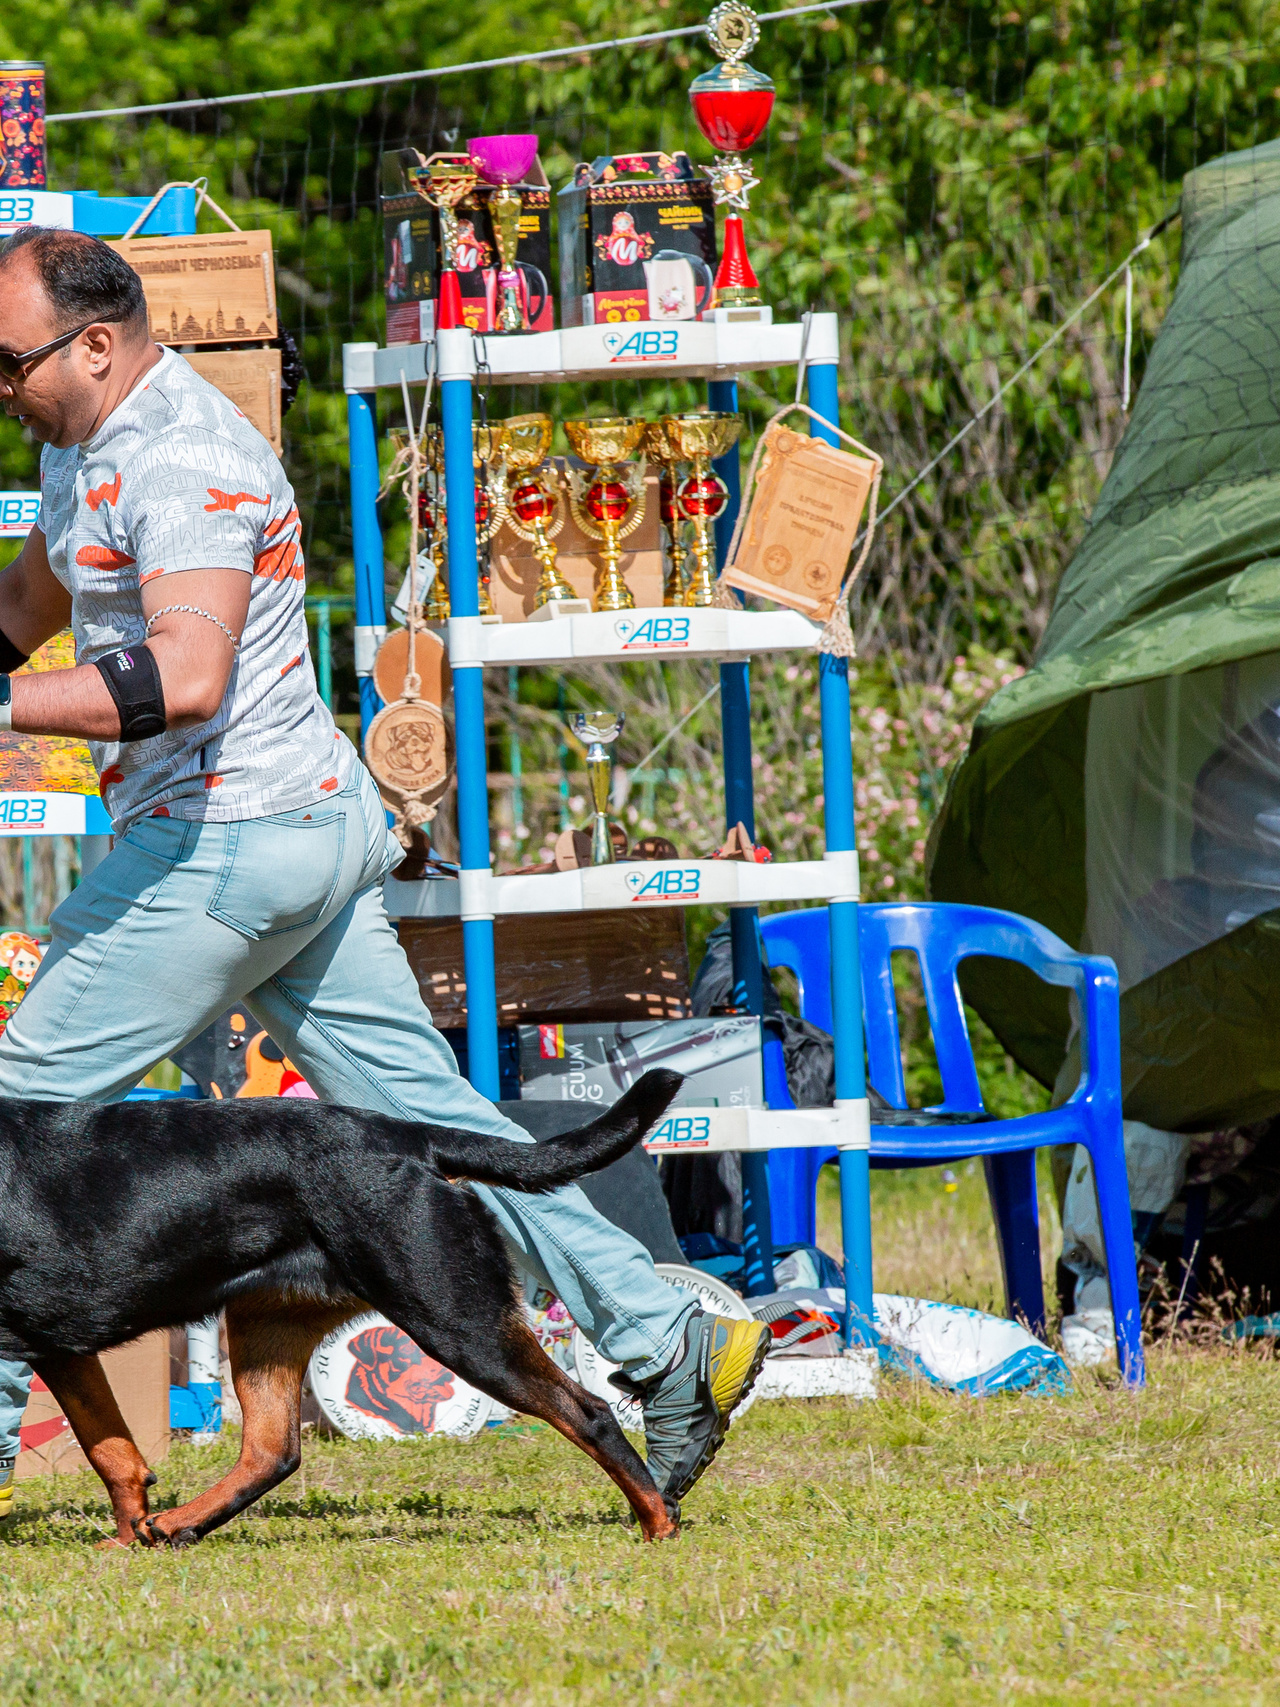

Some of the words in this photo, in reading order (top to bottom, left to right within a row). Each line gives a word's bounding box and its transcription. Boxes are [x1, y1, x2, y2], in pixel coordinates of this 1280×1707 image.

[129, 258, 188, 275] МПИОНАТ
[189, 253, 262, 272] ЧЕРНОЗЕМЬЯ
[569, 1043, 586, 1101] CUUM
